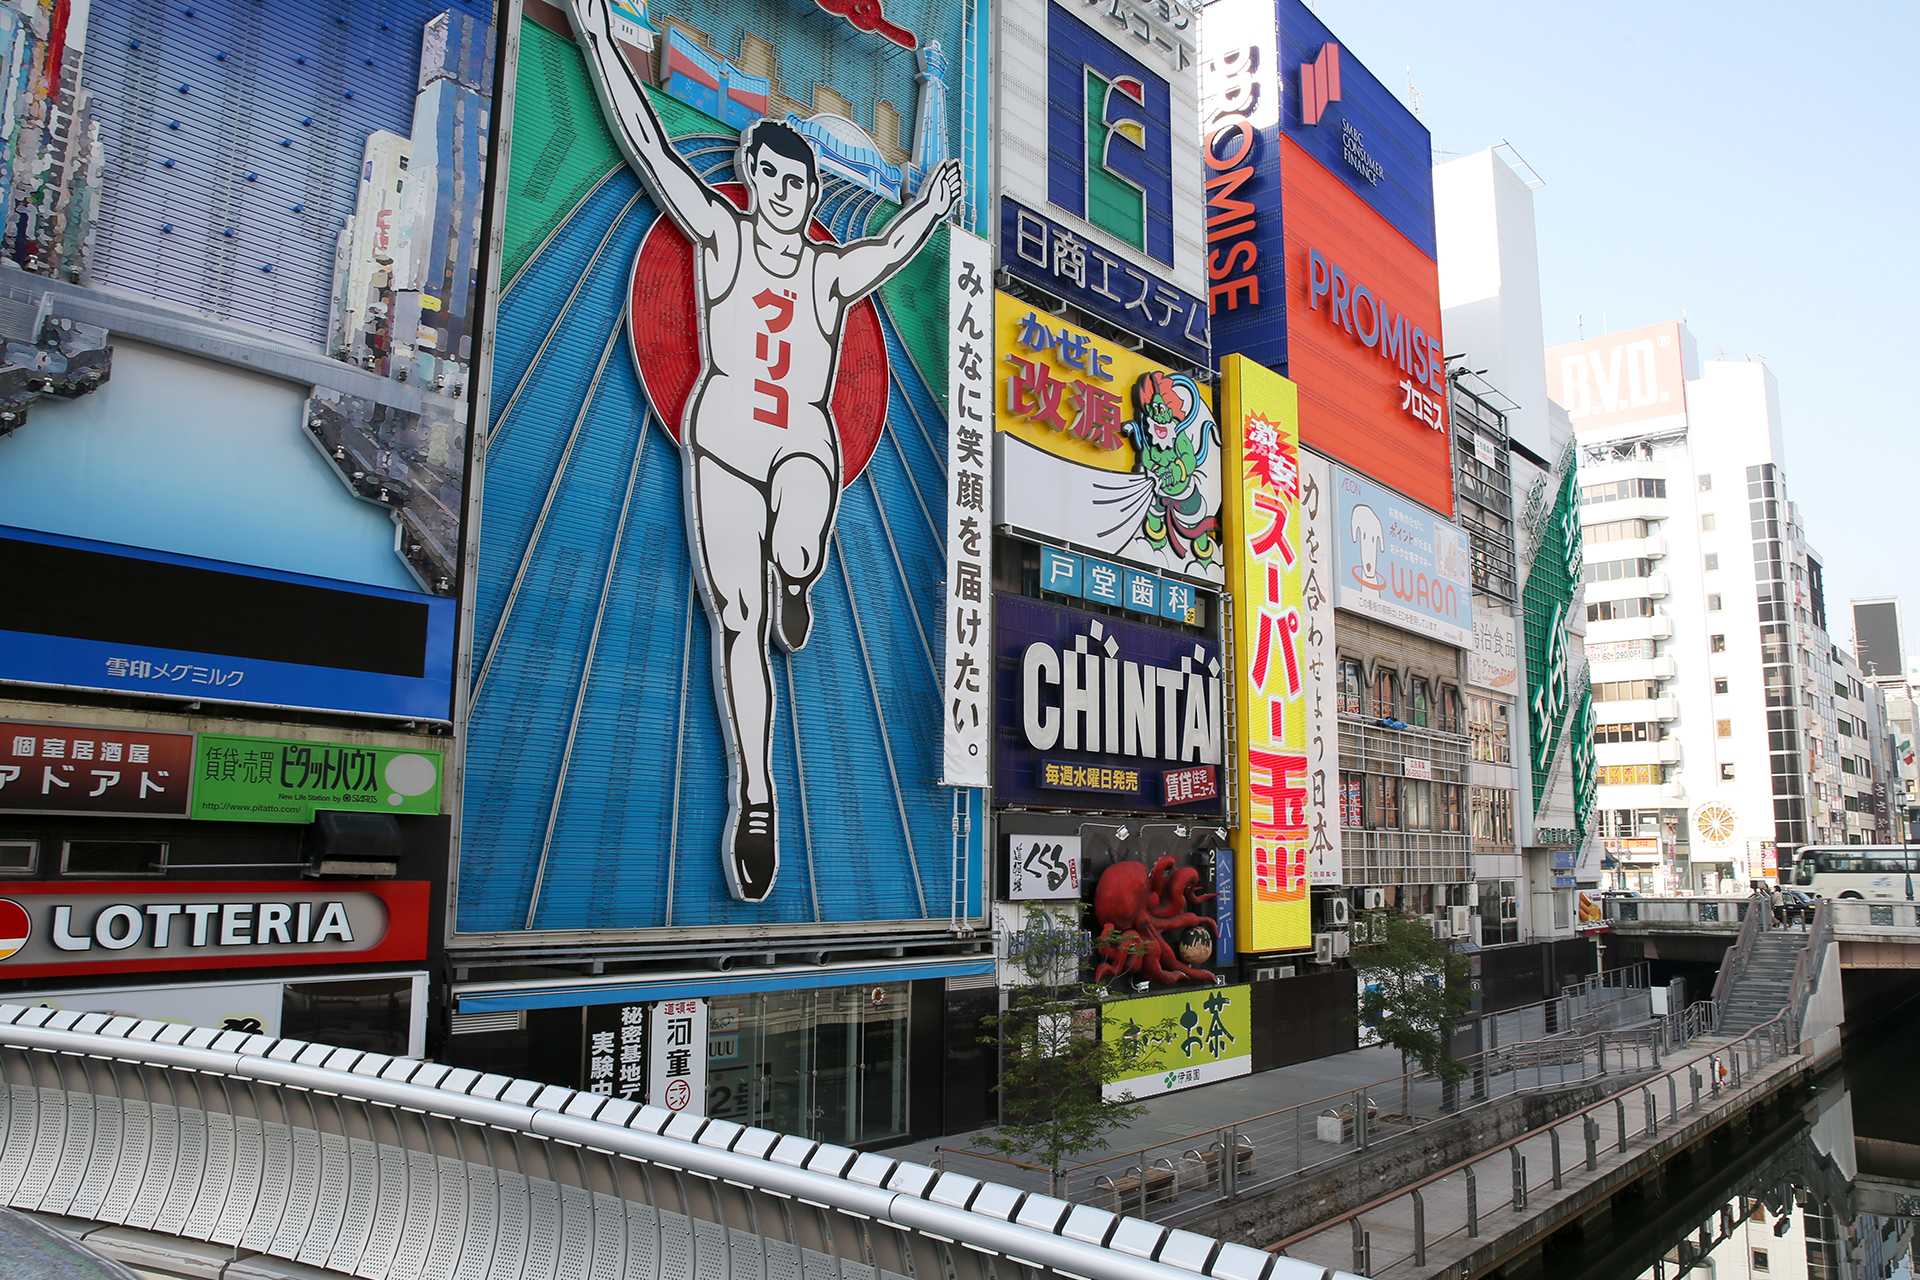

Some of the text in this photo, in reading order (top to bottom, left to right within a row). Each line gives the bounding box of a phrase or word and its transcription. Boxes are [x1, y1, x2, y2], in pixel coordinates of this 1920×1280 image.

[1342, 118, 1365, 148] SMBC
[1342, 132, 1385, 182] CONSUMER
[1204, 46, 1260, 316] PROMISE
[1343, 146, 1378, 187] FINANCE
[1017, 209, 1211, 349] 日商エステム
[1017, 311, 1115, 382] かぜに
[1307, 246, 1443, 397] PROMISE
[752, 287, 798, 430] グリコ
[1562, 338, 1669, 420] B.V.D.
[1007, 353, 1124, 451] 改源
[1399, 379, 1446, 434] プロミス
[952, 260, 985, 757] みんなに笑顔を届けたい。
[1049, 553, 1190, 617] 戸堂歯科
[1390, 561, 1458, 619] WAON
[1186, 609, 1195, 623] 3F
[105, 657, 244, 687] 雪印メグミルク
[1023, 628, 1221, 765] CHINTAI
[12, 736, 150, 764] 個室居酒屋
[204, 745, 378, 792] 賃貸・売買 ピタットハウス
[278, 793, 293, 801] New
[294, 793, 306, 801] Life
[307, 794, 330, 802] Station
[332, 795, 341, 804] by
[1045, 763, 1138, 792] 毎週水曜日発売
[1166, 771, 1193, 802] 賃貸
[1192, 769, 1208, 785] 住宅
[1193, 780, 1216, 798] ニュース
[202, 803, 302, 813] http://www.pitatto.com/
[1208, 849, 1216, 882] 2F
[52, 900, 355, 952] LOTTERIA
[1218, 857, 1233, 955] ペンギンバー
[664, 1001, 696, 1016] 道頓堀
[666, 1018, 693, 1078] 河童
[1177, 1069, 1200, 1084] 伊藤園
